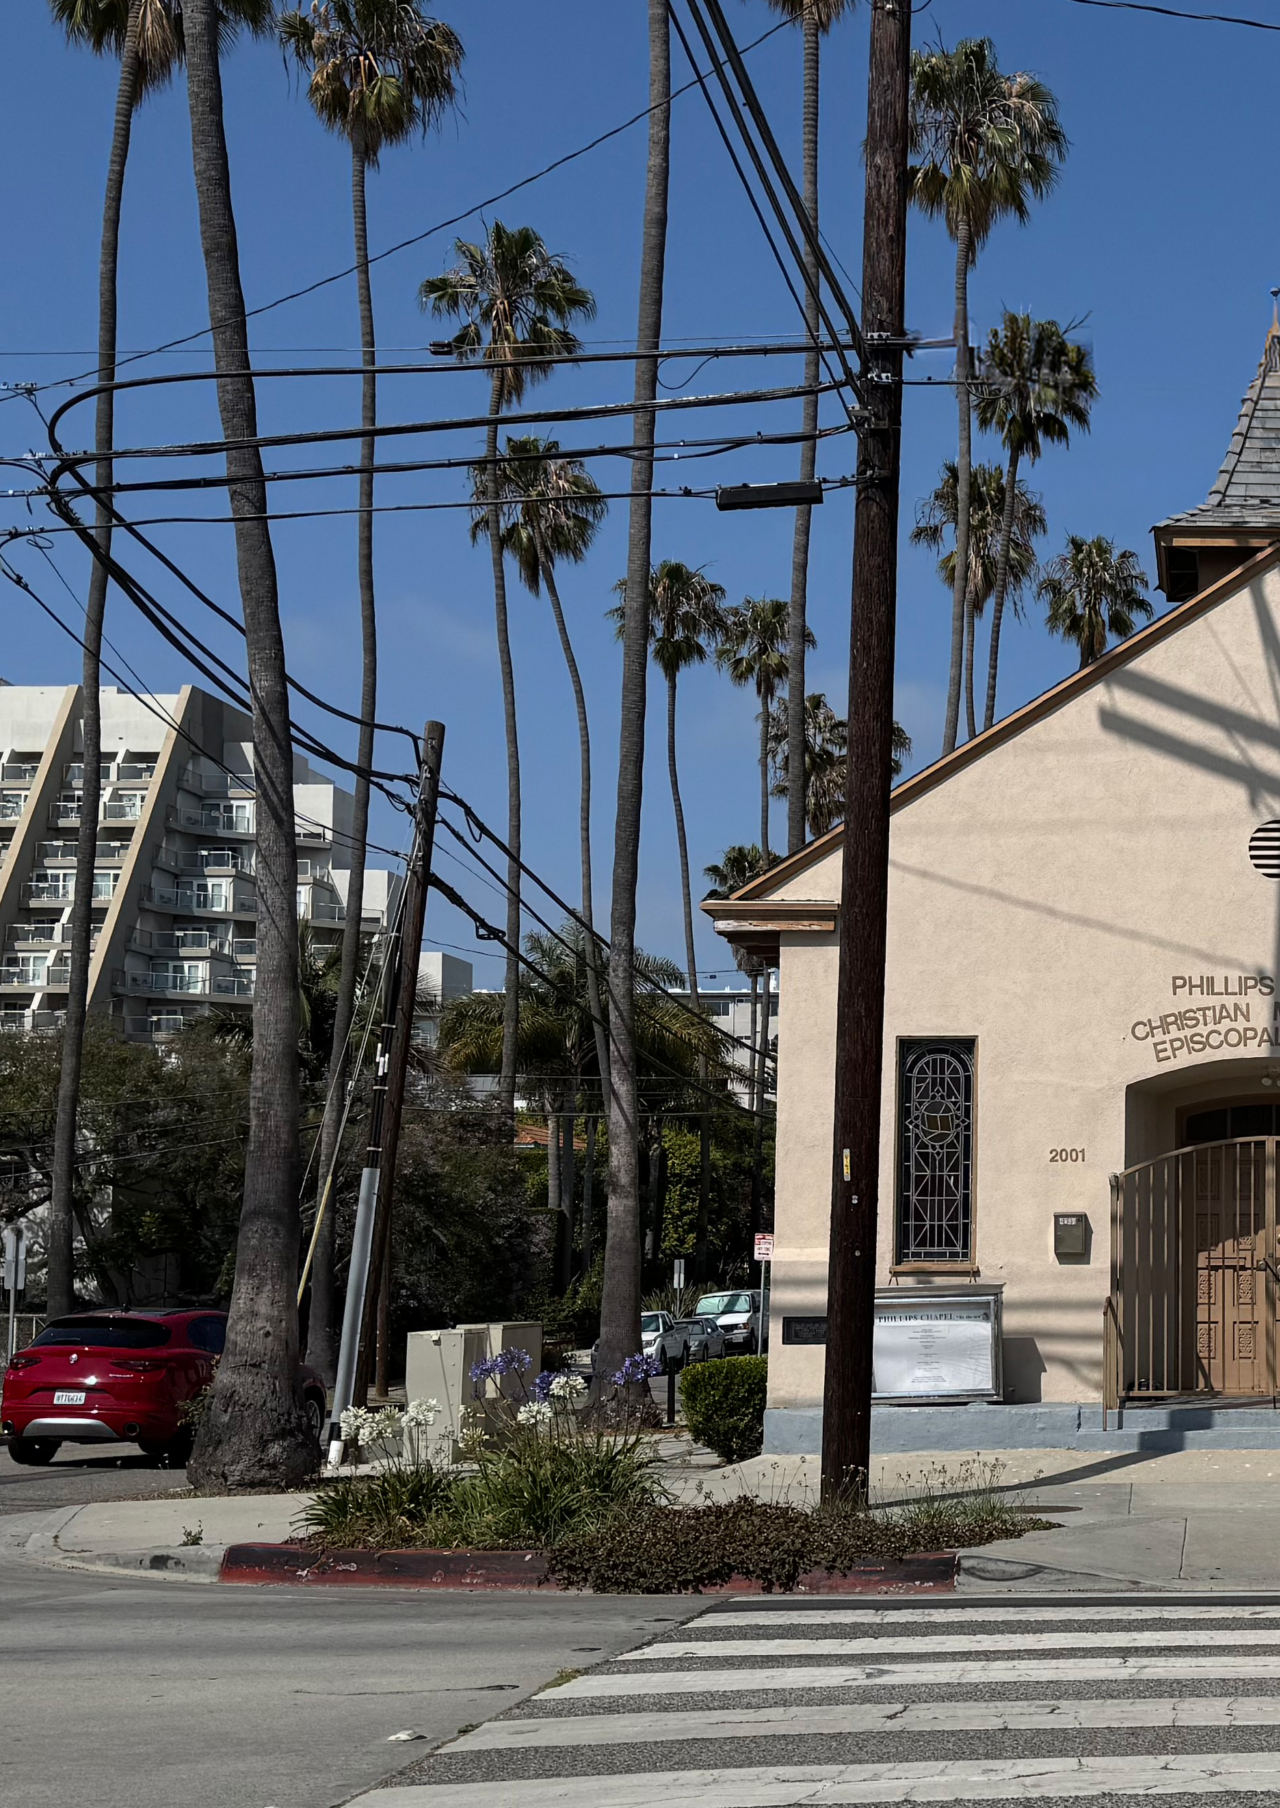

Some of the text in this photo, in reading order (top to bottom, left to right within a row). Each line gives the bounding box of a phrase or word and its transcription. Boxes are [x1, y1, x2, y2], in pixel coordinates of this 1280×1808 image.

[1171, 975, 1275, 996] PHILLIPS
[1130, 1002, 1251, 1042] CHRISTIAN
[1049, 1148, 1086, 1162] 2001
